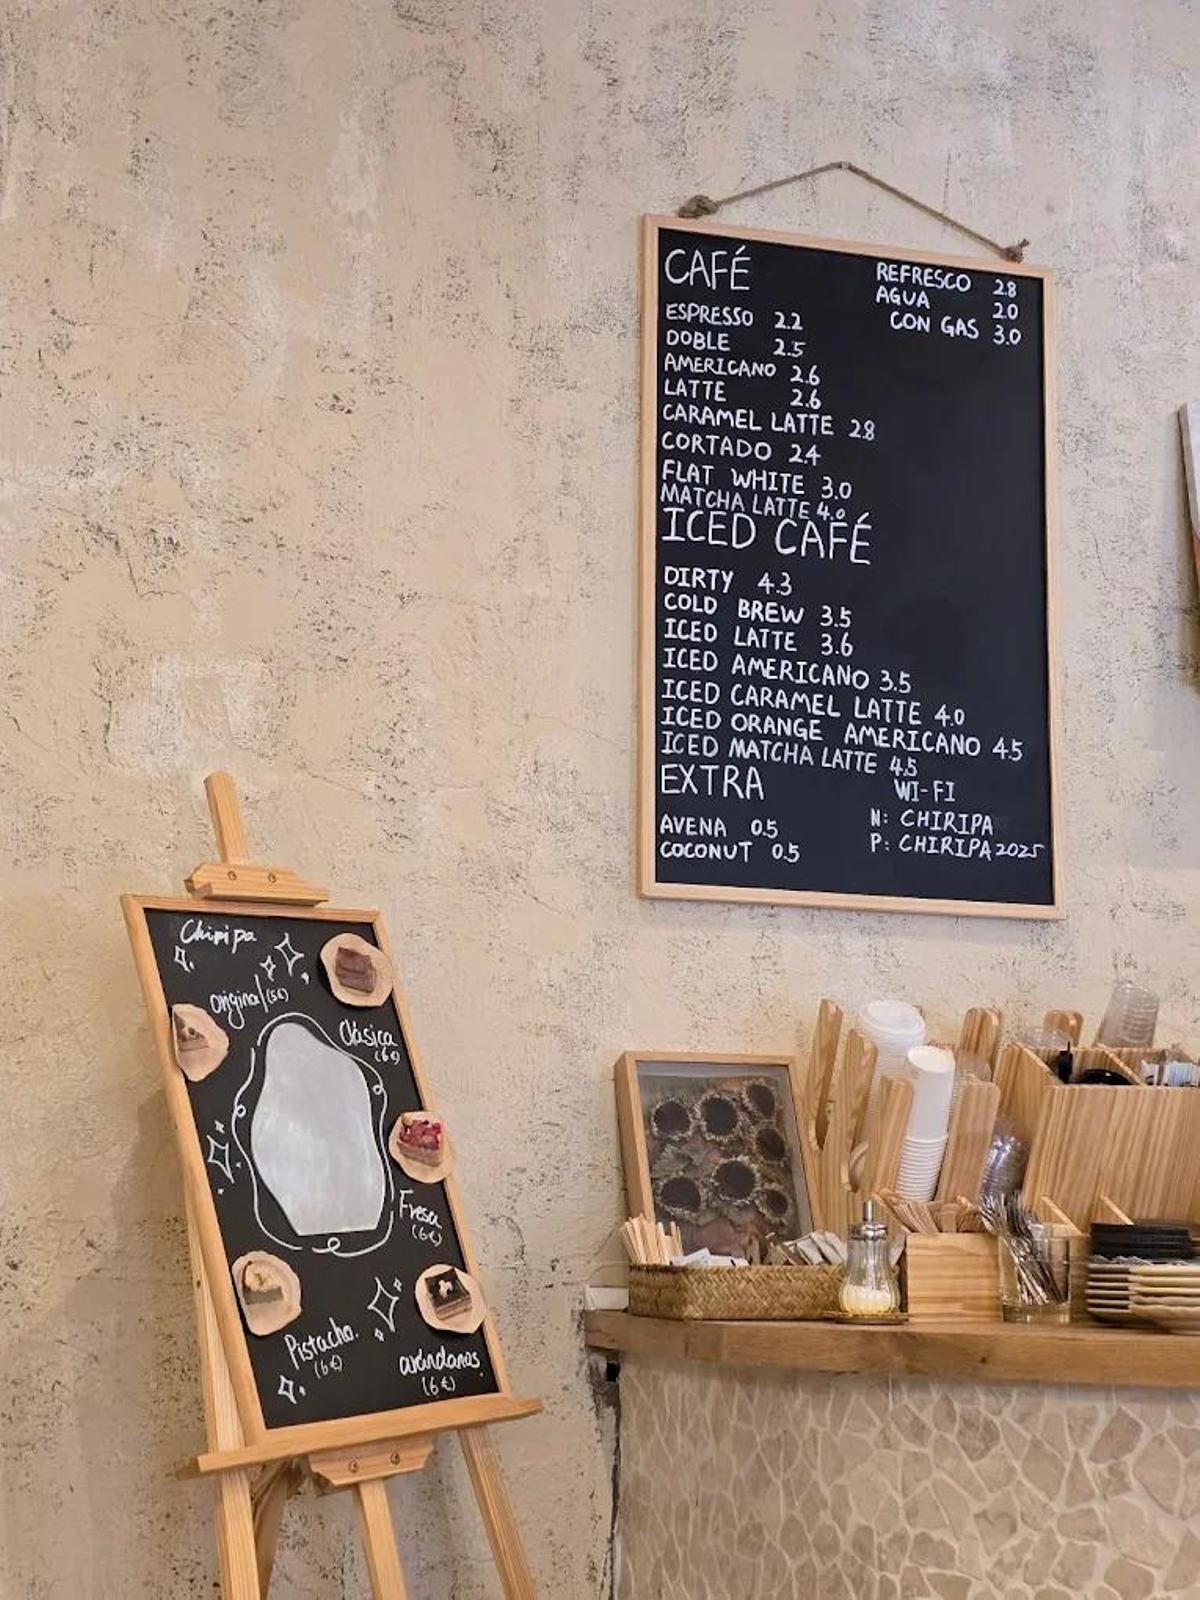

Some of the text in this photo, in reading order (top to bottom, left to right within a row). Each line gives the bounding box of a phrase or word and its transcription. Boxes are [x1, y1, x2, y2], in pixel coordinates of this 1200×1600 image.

[665, 245, 750, 290] CAFÉ
[877, 262, 971, 291] REFRESCO
[876, 285, 930, 309] AGUA
[666, 303, 803, 330] ESPRESSO 2.2
[891, 311, 1021, 345] CON GAS 3.0
[667, 330, 805, 357] DOBLE 2.5
[665, 353, 820, 385] AMERICANO 2.6
[665, 379, 821, 409] LATTE 2.6
[663, 403, 762, 430] CARAMEL
[772, 412, 833, 435] LATTE
[662, 431, 821, 466] CORTADO 2.4
[663, 459, 851, 499] FLAT WHITE 3.0
[661, 483, 845, 520] MATCHA LATTE 4.0
[662, 507, 871, 564] ICED CAFÉ
[665, 566, 792, 596] DIRTY 4.3
[665, 593, 851, 628] COLD BREW 3.5
[665, 618, 853, 656] ICED LATTE 3.6
[663, 648, 911, 693] ICED AMERICANO 3.5
[662, 679, 964, 727] ICED CARAMEL LATTE 4.0
[661, 706, 721, 729] ICED
[731, 713, 823, 741] ORANGE
[843, 723, 980, 756] AMERICANO
[662, 731, 718, 757] ICED
[729, 738, 813, 765] MATCHA
[822, 747, 877, 773] LATTE
[662, 764, 764, 800] EXTRA
[894, 779, 955, 802] WI-FI
[660, 814, 726, 837] AVENA
[900, 809, 993, 835] CHIRIPA
[660, 841, 752, 862] COCONUT
